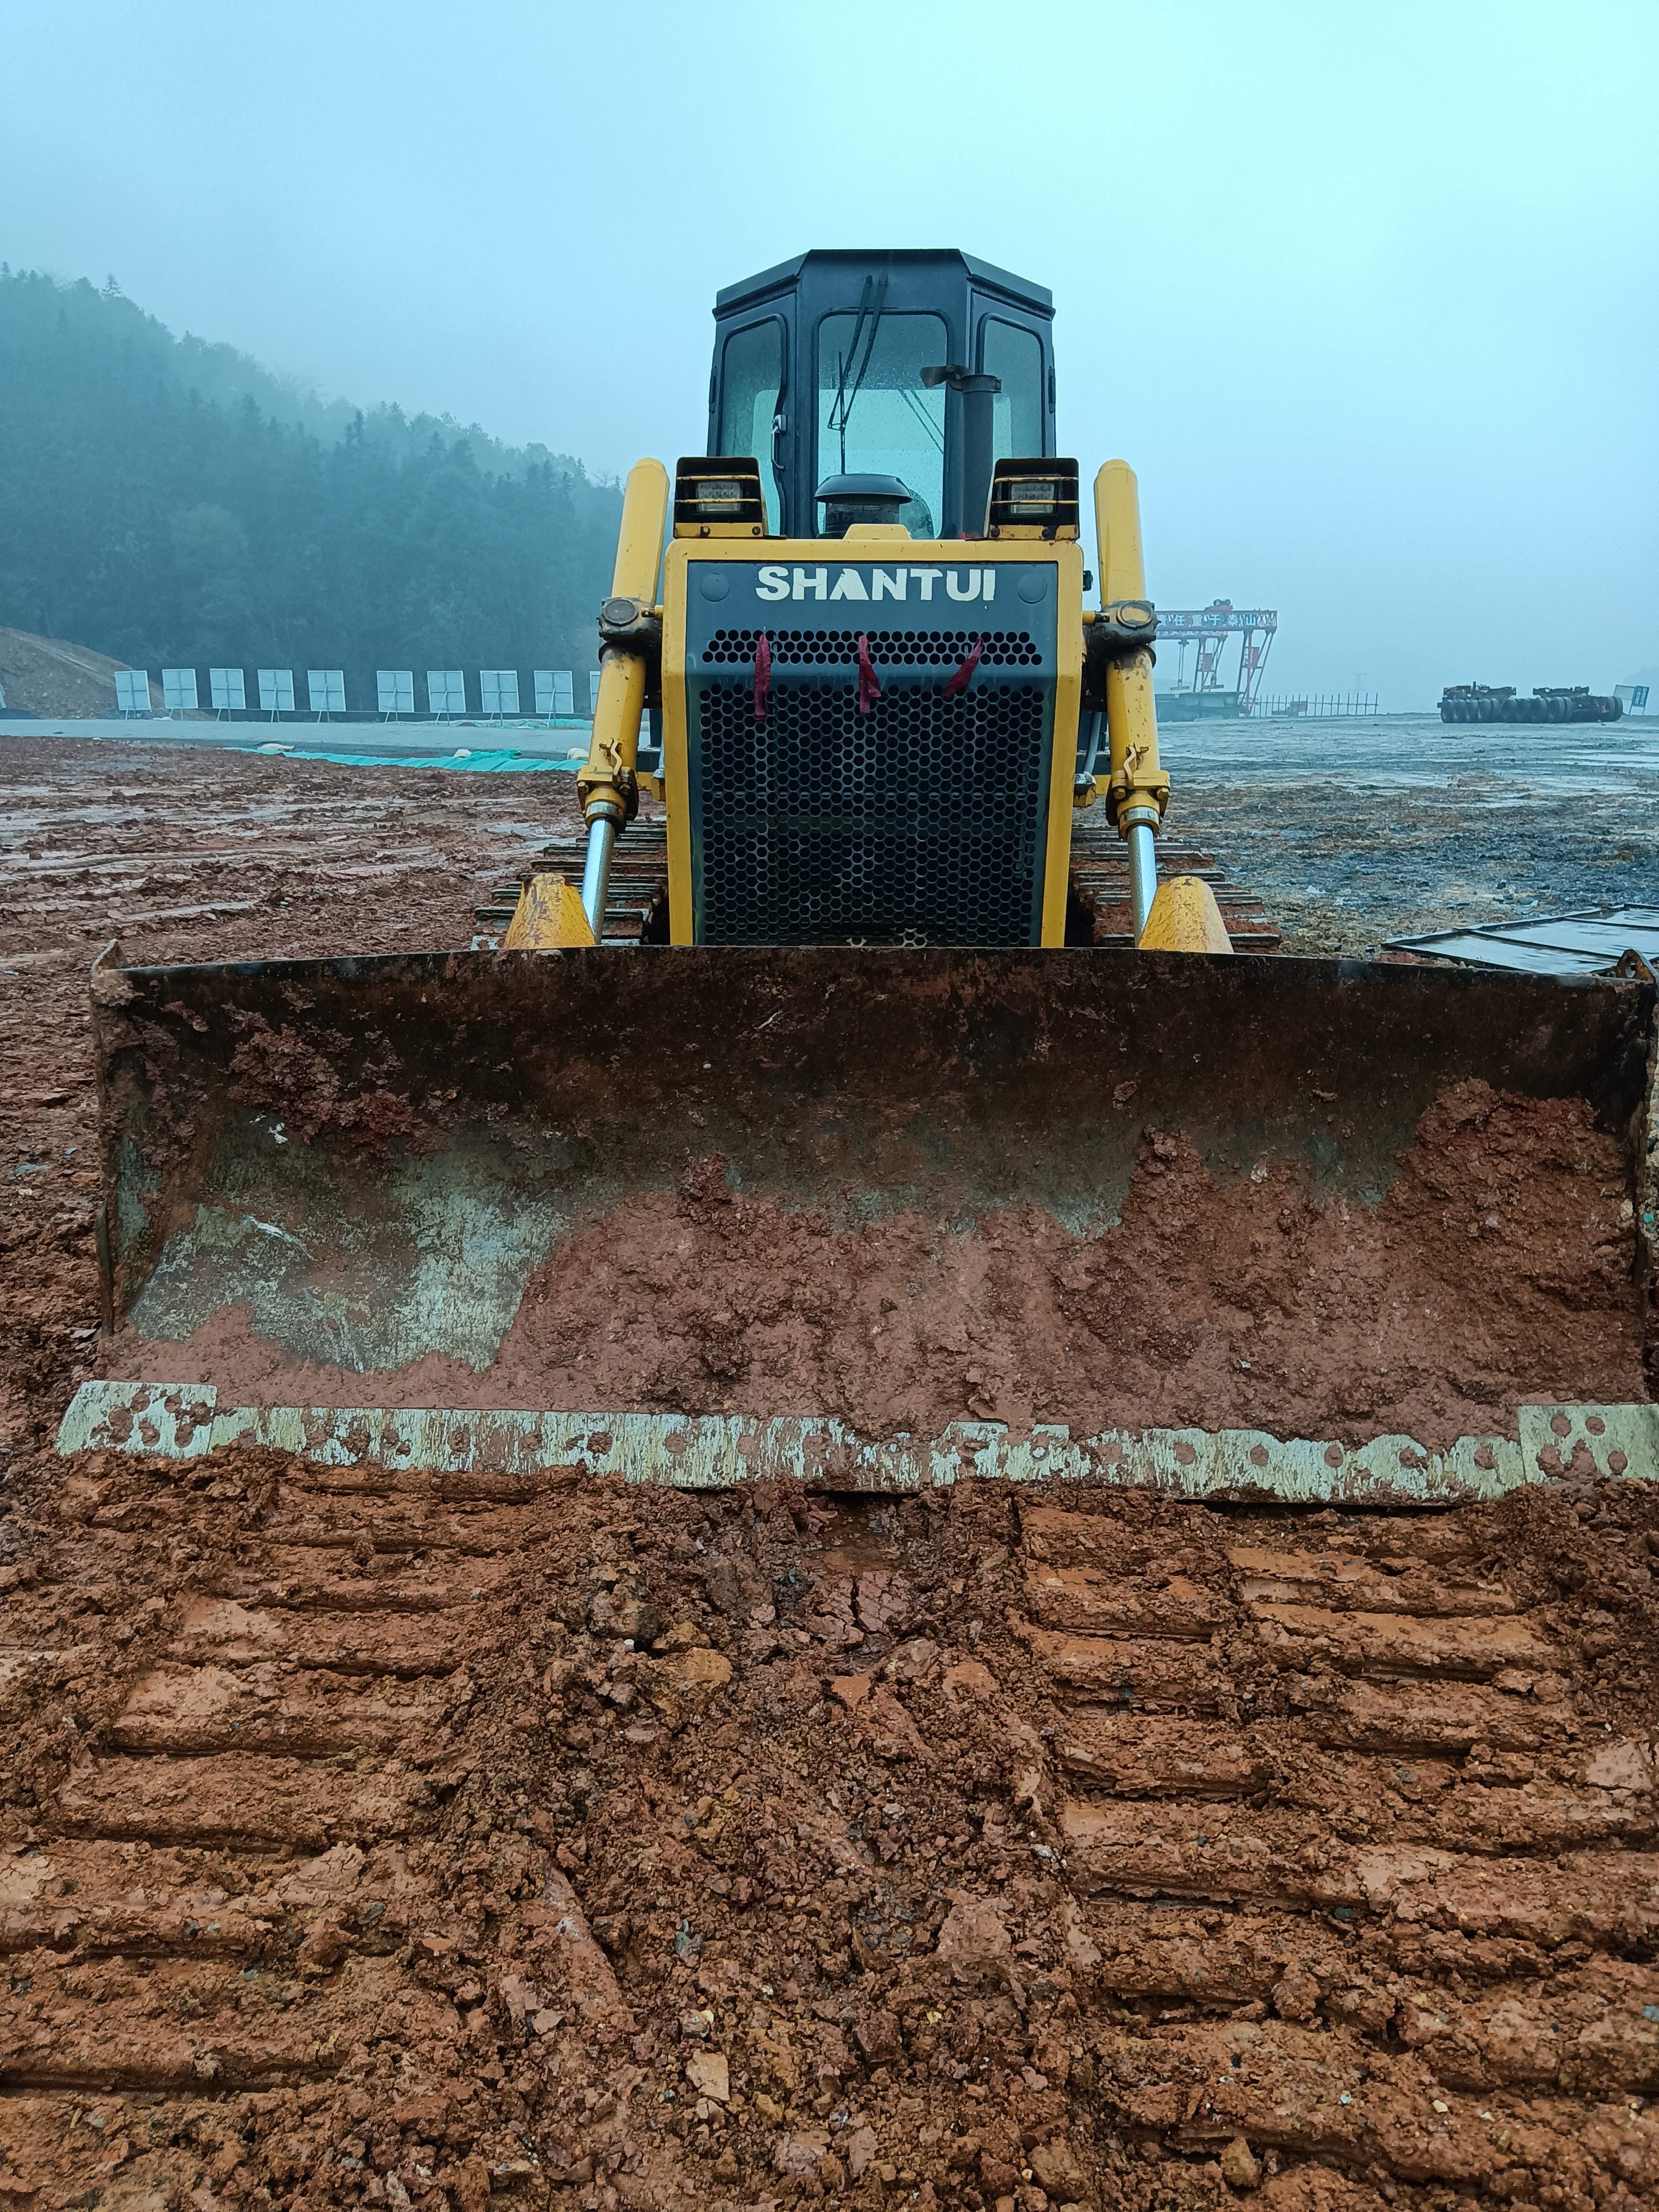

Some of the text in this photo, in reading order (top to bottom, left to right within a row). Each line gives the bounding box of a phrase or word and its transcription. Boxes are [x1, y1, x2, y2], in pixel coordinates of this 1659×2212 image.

[755, 566, 995, 601] SHANTUI
[1156, 614, 1256, 628] 责任重于泰山
